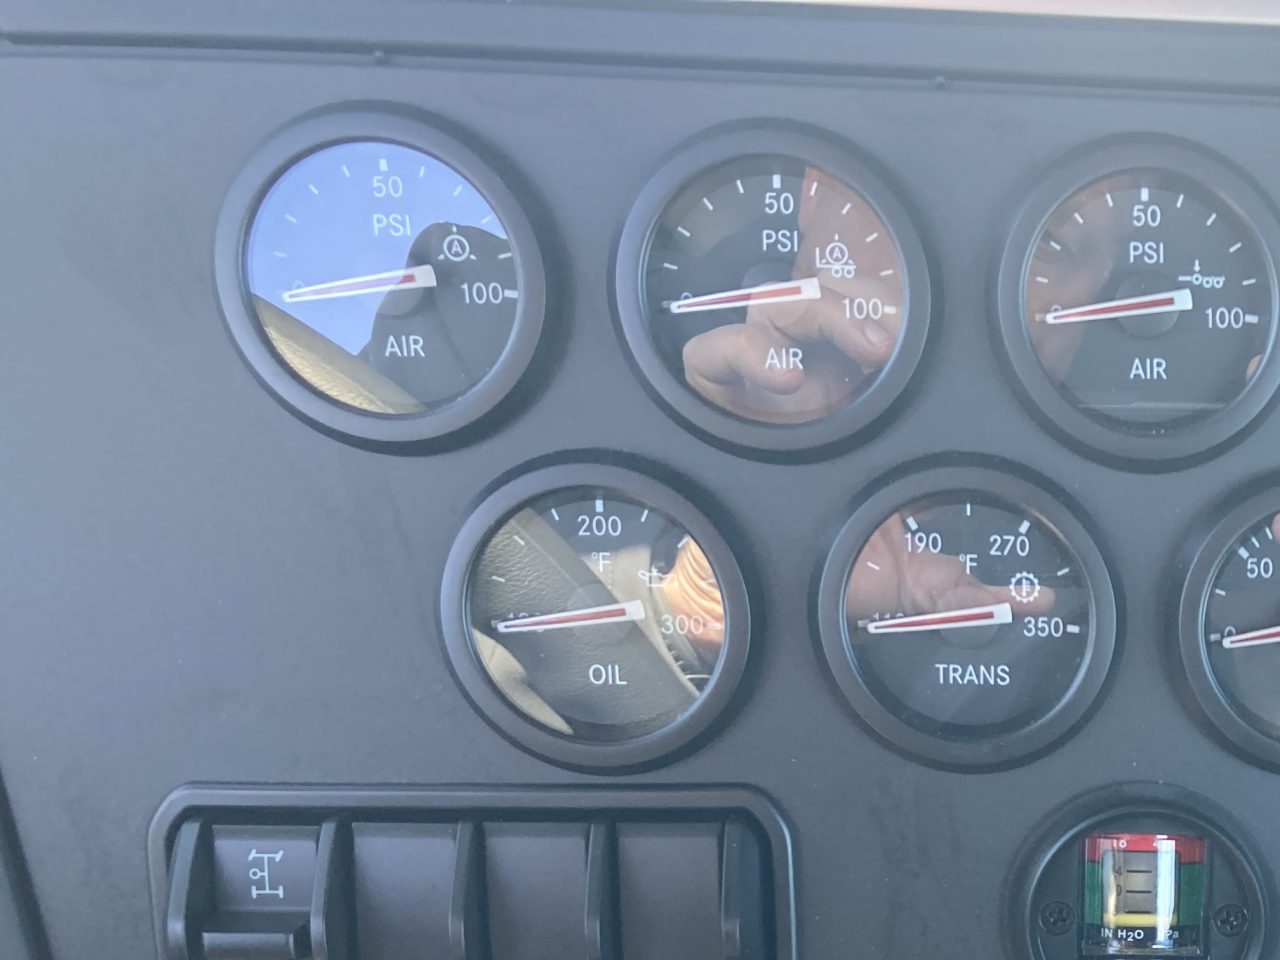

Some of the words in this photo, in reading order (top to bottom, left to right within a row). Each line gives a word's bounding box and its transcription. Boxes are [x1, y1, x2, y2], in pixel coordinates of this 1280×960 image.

[372, 175, 403, 198] 50
[764, 193, 794, 215] 50
[372, 213, 412, 237] PSI
[1132, 204, 1161, 227] 50
[762, 229, 799, 252] PSI
[1129, 241, 1164, 264] PSI
[460, 282, 503, 304] 100
[843, 297, 883, 320] 100
[1205, 307, 1244, 329] 100
[384, 335, 426, 358] AIR
[764, 347, 804, 370] AIR
[1129, 358, 1168, 380] AIR
[577, 515, 622, 537] 200
[904, 532, 942, 553] 190
[989, 535, 1030, 557] 270
[1246, 557, 1273, 579] 50
[661, 614, 704, 635] 300
[1022, 616, 1064, 638] 350
[588, 663, 628, 685] OIL
[935, 663, 1011, 686] TRANS
